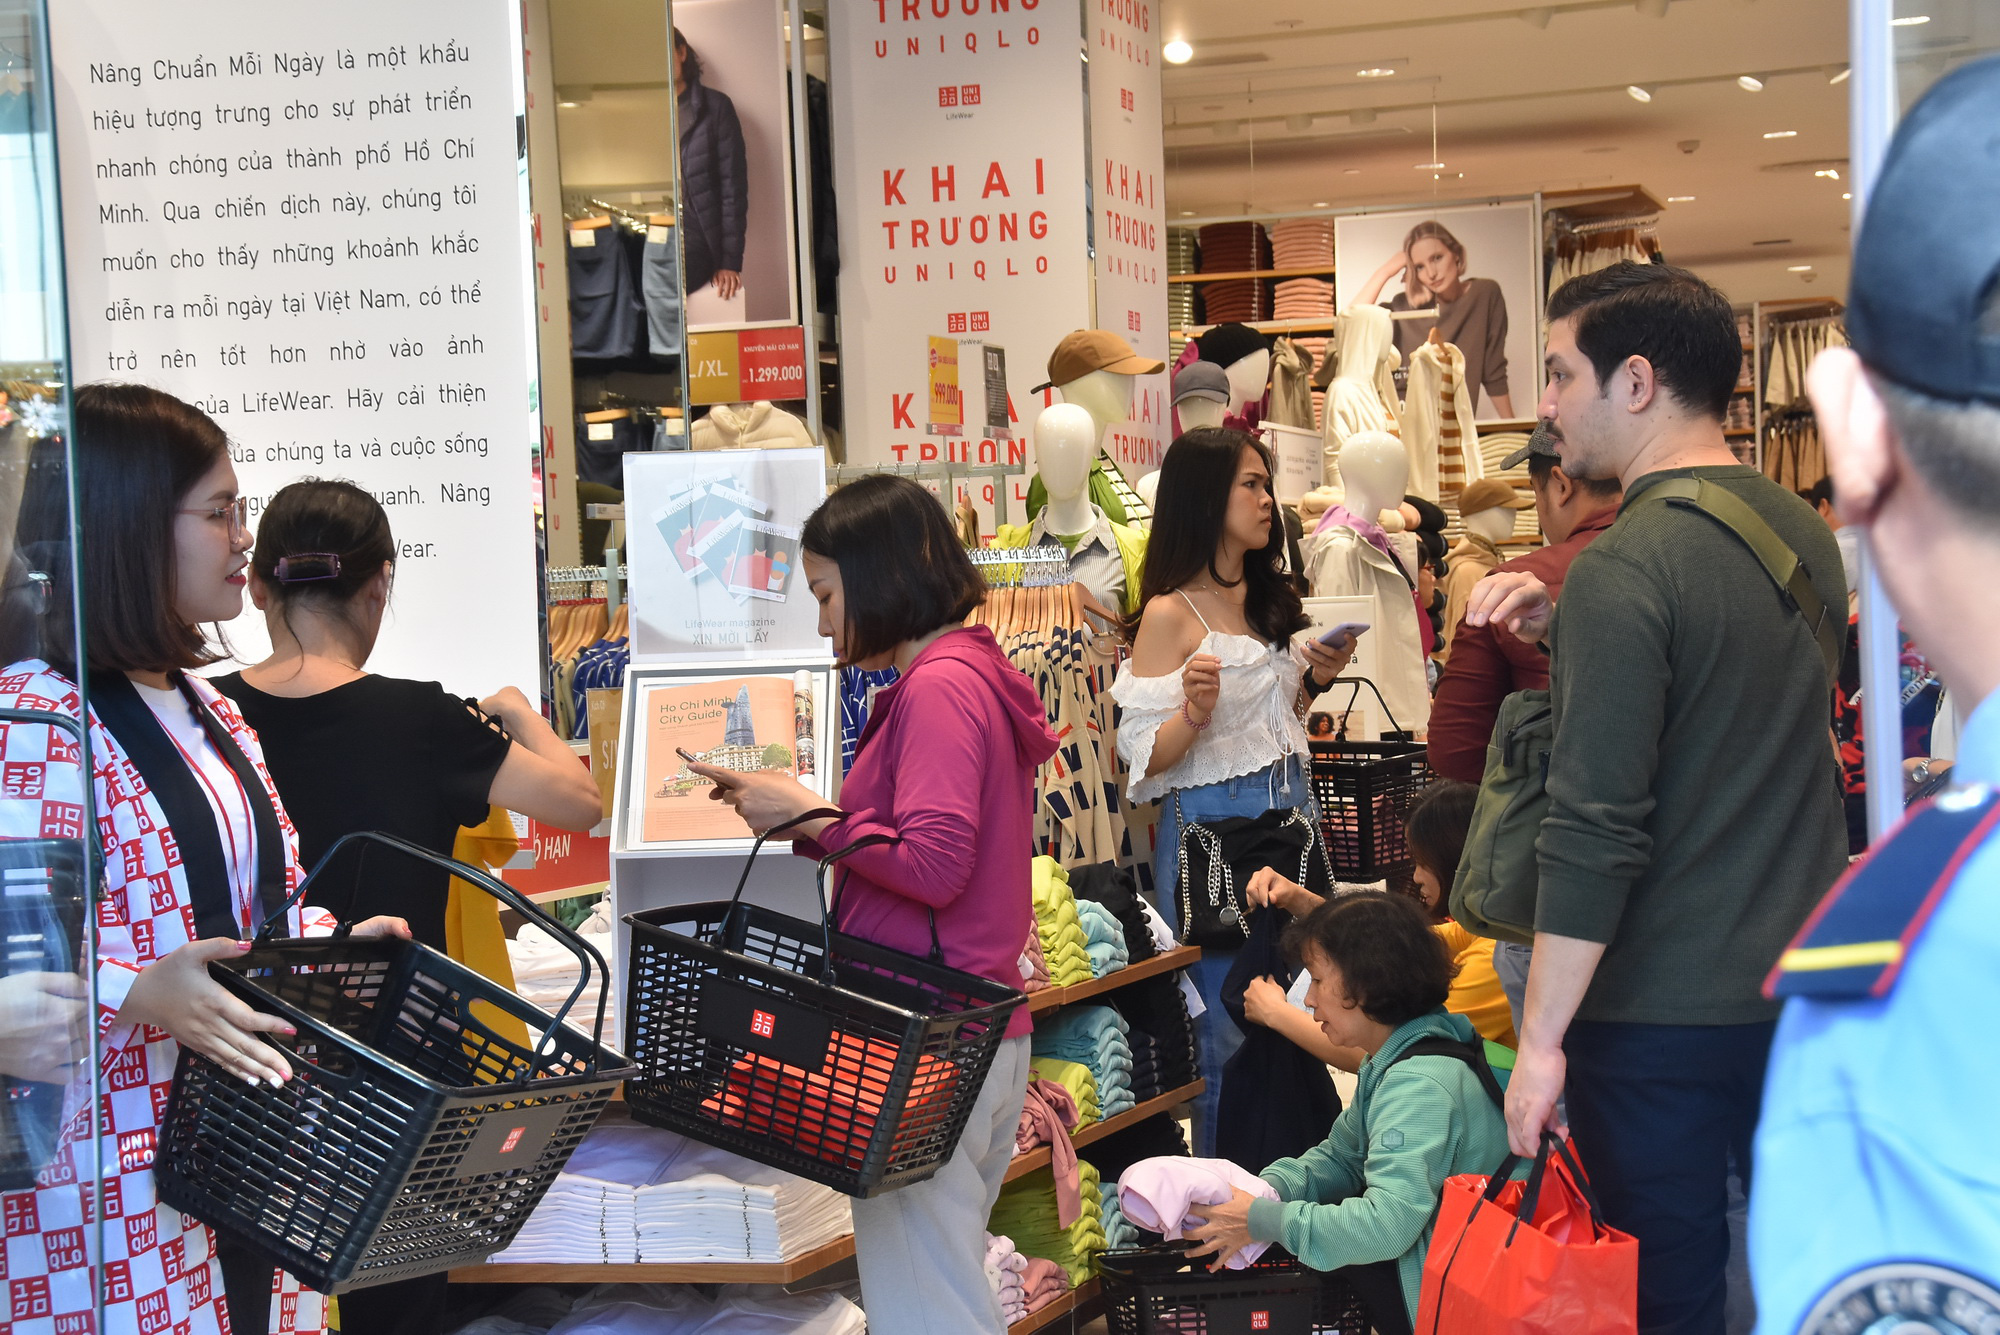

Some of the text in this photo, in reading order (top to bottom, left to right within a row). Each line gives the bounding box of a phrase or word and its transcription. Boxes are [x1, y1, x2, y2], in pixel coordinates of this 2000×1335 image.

[875, 27, 1040, 58] UNIQLO
[89, 38, 470, 88] Nâng Chuẩn Mỗi Ngày là một khẩu
[92, 85, 472, 135] hiệu tượng trưng cho sự phát triển
[96, 137, 475, 179] nhanh chóng của thành phố Hồ Chí
[883, 158, 1044, 206] KHAI
[1105, 158, 1154, 210] KHAI
[99, 183, 477, 225] Minh. Qua chiến dịch này, chúng tôi
[882, 210, 1048, 250] TRƯƠNG
[102, 229, 479, 272] muốn cho thấy những khoảnh khắc
[885, 255, 1048, 284] UNIQLO
[105, 279, 482, 322] diễn ra mỗi ngày tại Việt Nam, có thể
[107, 333, 484, 371] trở nên tốt hơn nhờ vào ảnh
[958, 337, 984, 347] ifeWear
[749, 364, 803, 383] 1.299.000
[242, 390, 334, 413] LifeWear.
[347, 387, 384, 413] Hãy
[397, 384, 425, 406] cải
[438, 382, 486, 407] thiện
[230, 430, 489, 466] ủa chúng ta và cuộc sống
[369, 482, 491, 507] uanh. Nâng
[395, 538, 438, 559] ear.
[685, 616, 776, 630] LifeWear magazine
[692, 633, 713, 646] XIN
[745, 627, 770, 644] LẤY
[659, 709, 723, 725] City Guide
[660, 695, 733, 714] Ho Chi Minh
[543, 834, 571, 865] HẠN
[120, 1132, 150, 1152] UNI
[128, 1213, 154, 1235] UNI
[46, 1231, 79, 1251] UNI
[139, 1293, 165, 1316] UNI
